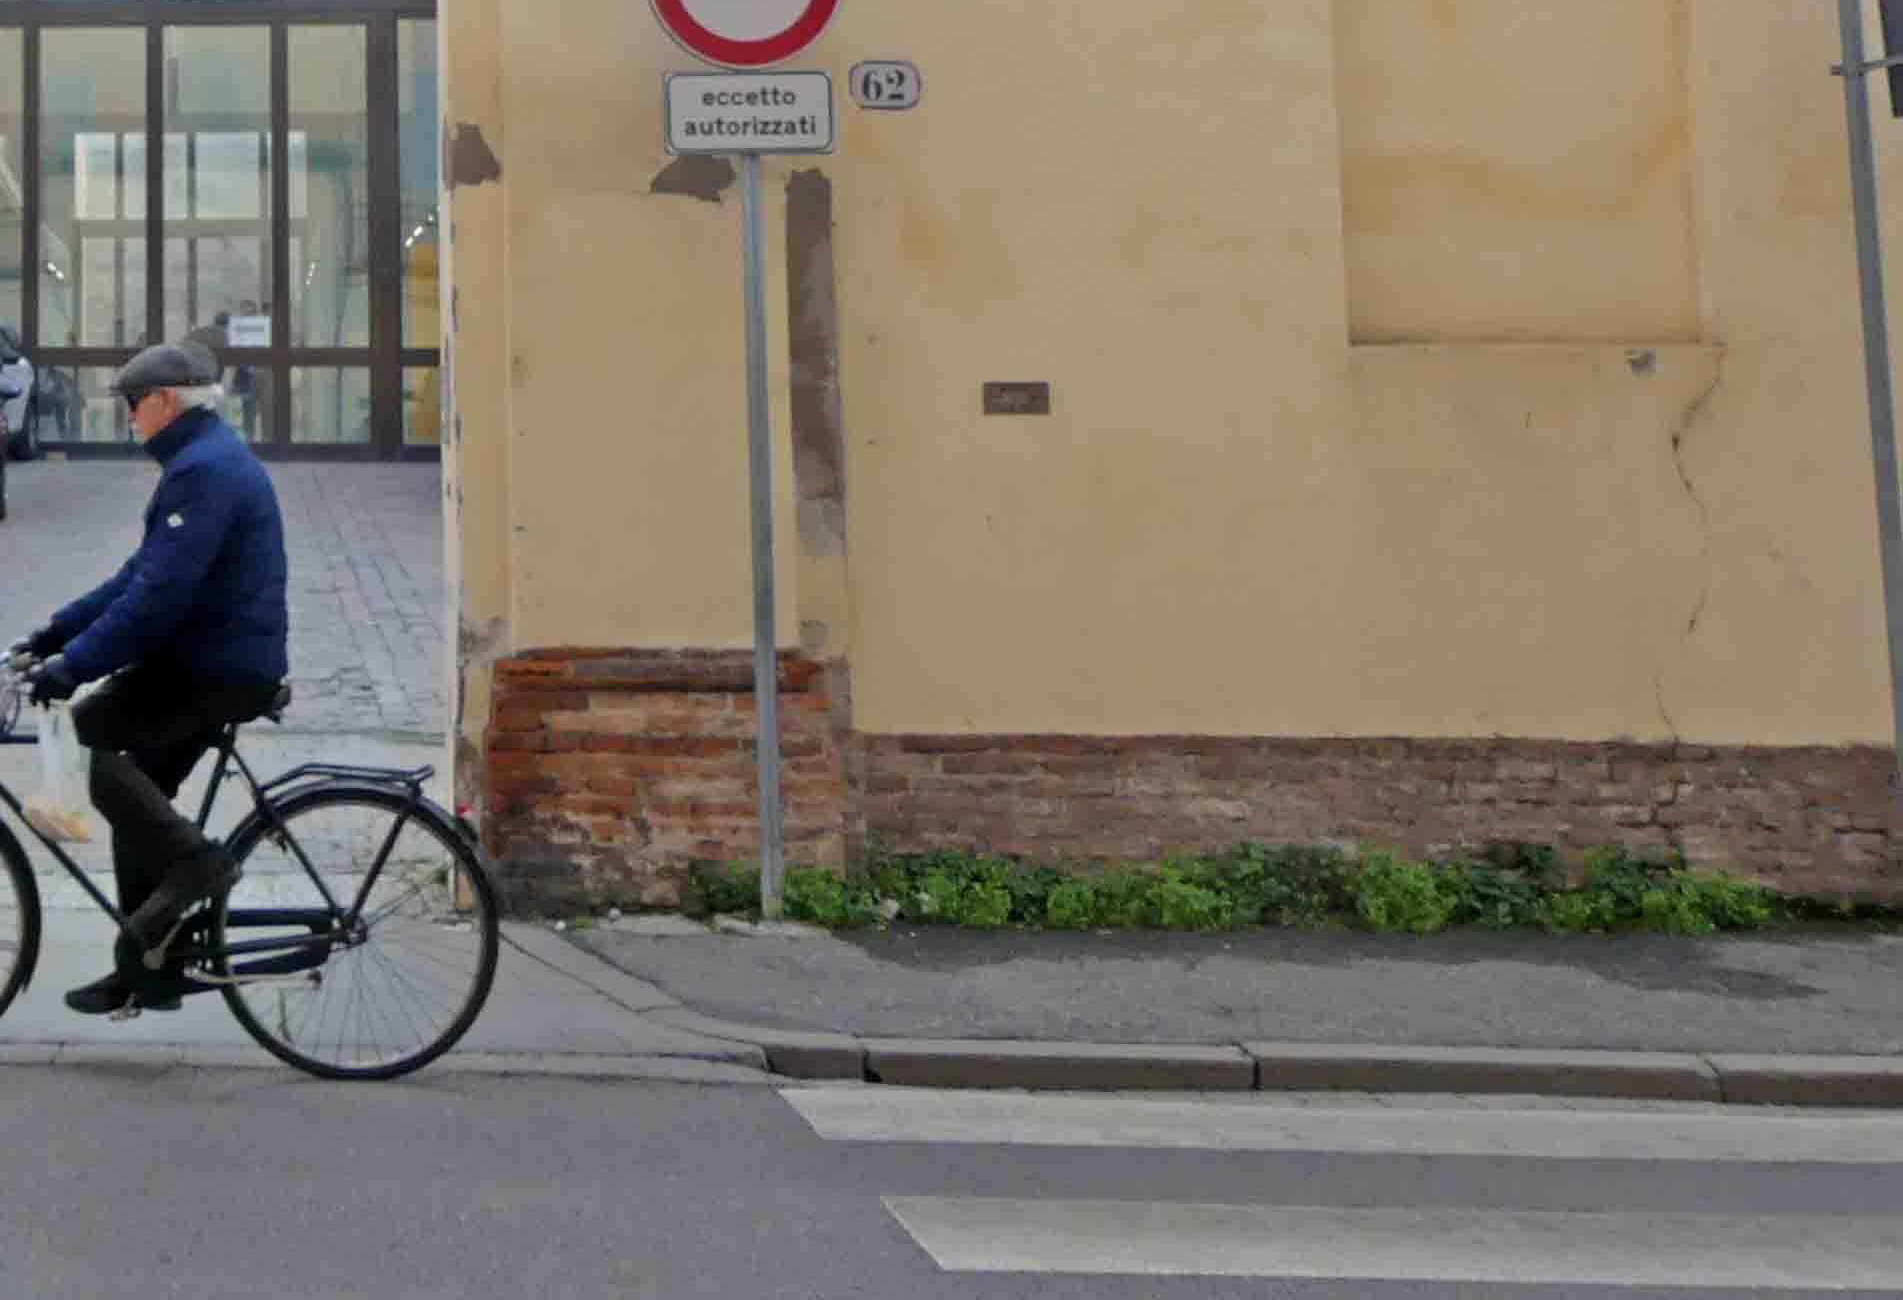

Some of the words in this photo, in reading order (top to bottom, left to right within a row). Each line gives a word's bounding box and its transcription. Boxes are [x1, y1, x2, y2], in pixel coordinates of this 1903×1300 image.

[861, 69, 906, 101] 62
[701, 86, 797, 107] eccetto
[684, 116, 817, 136] autorizzati
